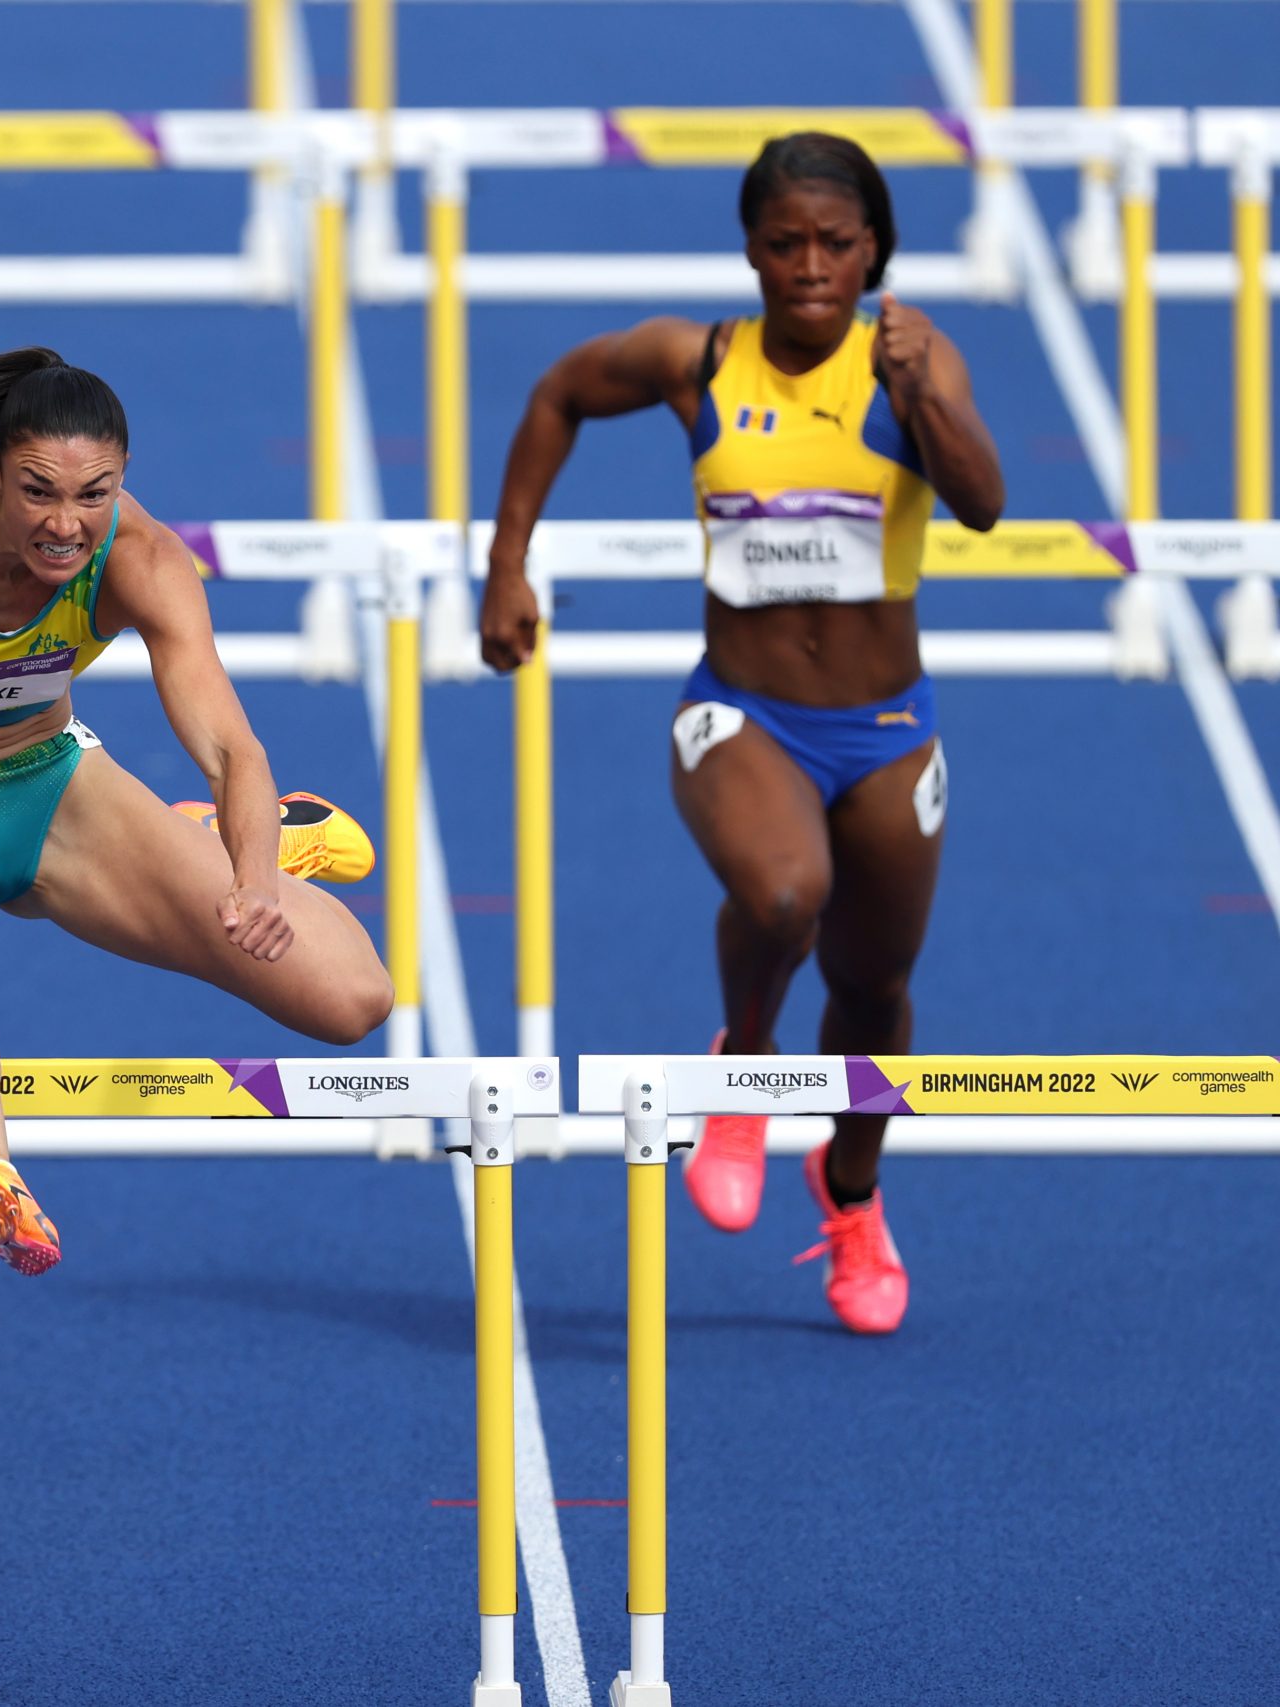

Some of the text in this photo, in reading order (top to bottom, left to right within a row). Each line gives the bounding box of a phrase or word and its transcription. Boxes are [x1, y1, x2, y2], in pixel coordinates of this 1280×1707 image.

[742, 539, 839, 565] CONNELL
[6, 653, 70, 670] commonwealth
[22, 662, 52, 672] games
[111, 1073, 214, 1085] commonwealth
[308, 1076, 410, 1091] LONGINES
[726, 1072, 828, 1087] LONGINES
[922, 1073, 1096, 1093] BIRMINGHAM 2022
[1172, 1070, 1274, 1082] commonwealth
[0, 1075, 35, 1095] 022
[139, 1085, 186, 1098] games
[1200, 1083, 1246, 1096] games
